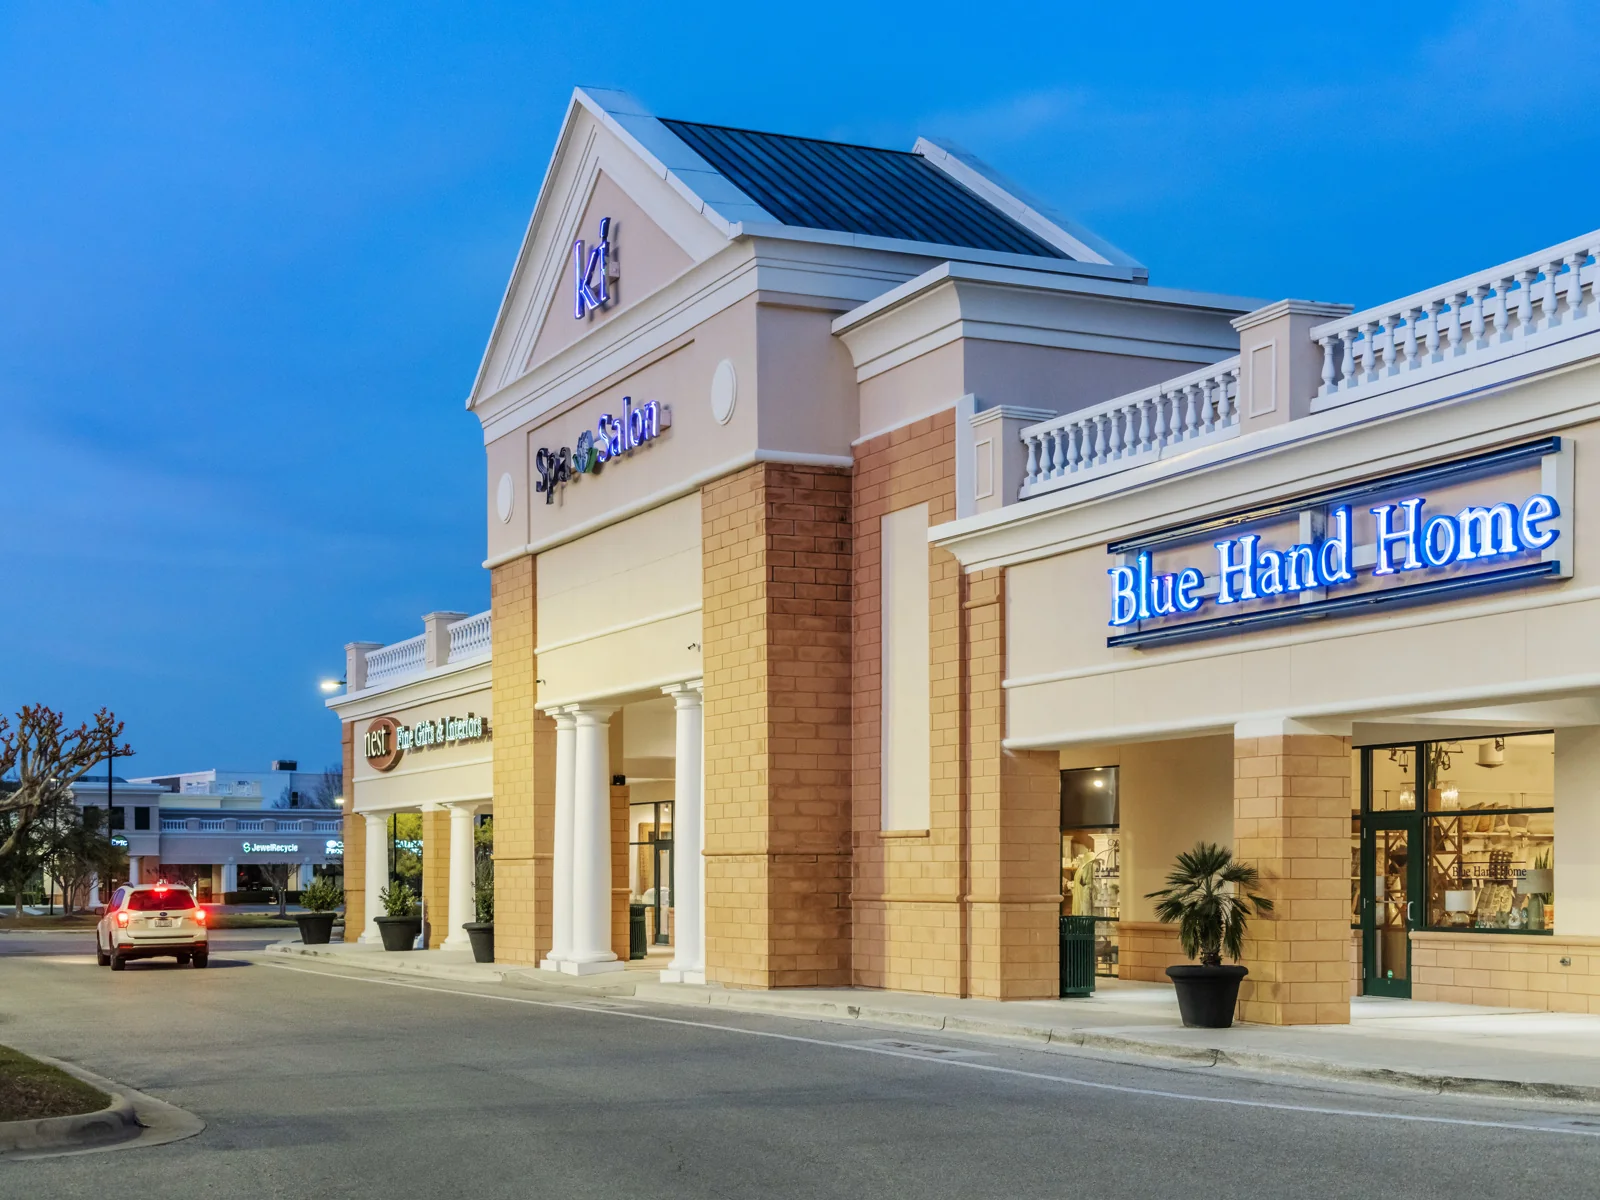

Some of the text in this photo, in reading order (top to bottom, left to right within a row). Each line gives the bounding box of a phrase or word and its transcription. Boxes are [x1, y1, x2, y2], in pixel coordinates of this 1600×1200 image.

[1108, 494, 1561, 627] Blue Hand Home
[364, 726, 388, 757] nest
[396, 713, 483, 750] Fine Gifts & Interiors
[251, 843, 299, 853] JewelRecycle
